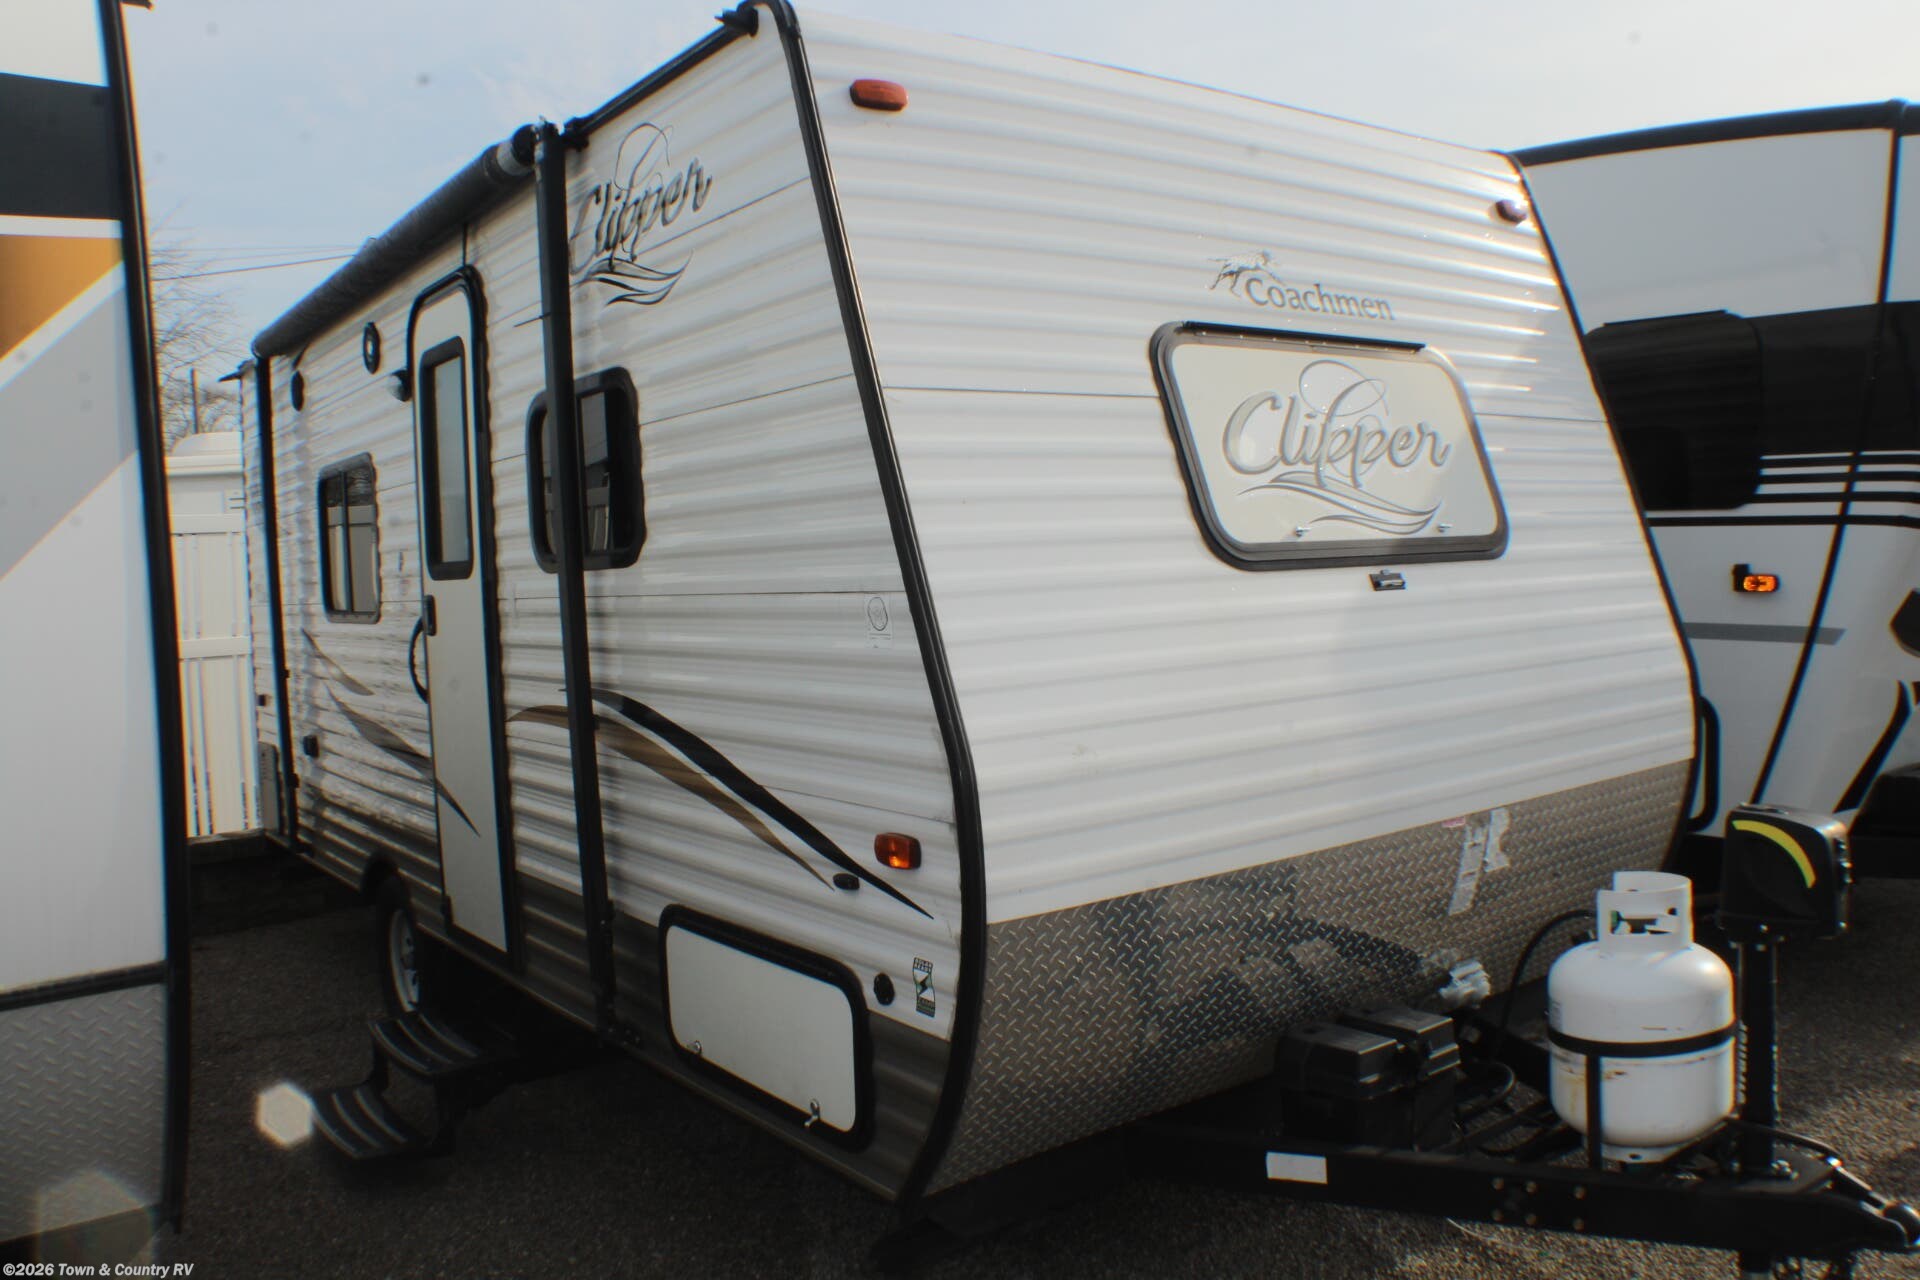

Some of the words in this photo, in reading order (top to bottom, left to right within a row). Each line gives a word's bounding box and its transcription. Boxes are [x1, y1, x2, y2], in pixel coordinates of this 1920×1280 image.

[569, 123, 713, 274] Clipper
[1245, 277, 1395, 321] Coachmen
[1222, 360, 1450, 490] Clipper
